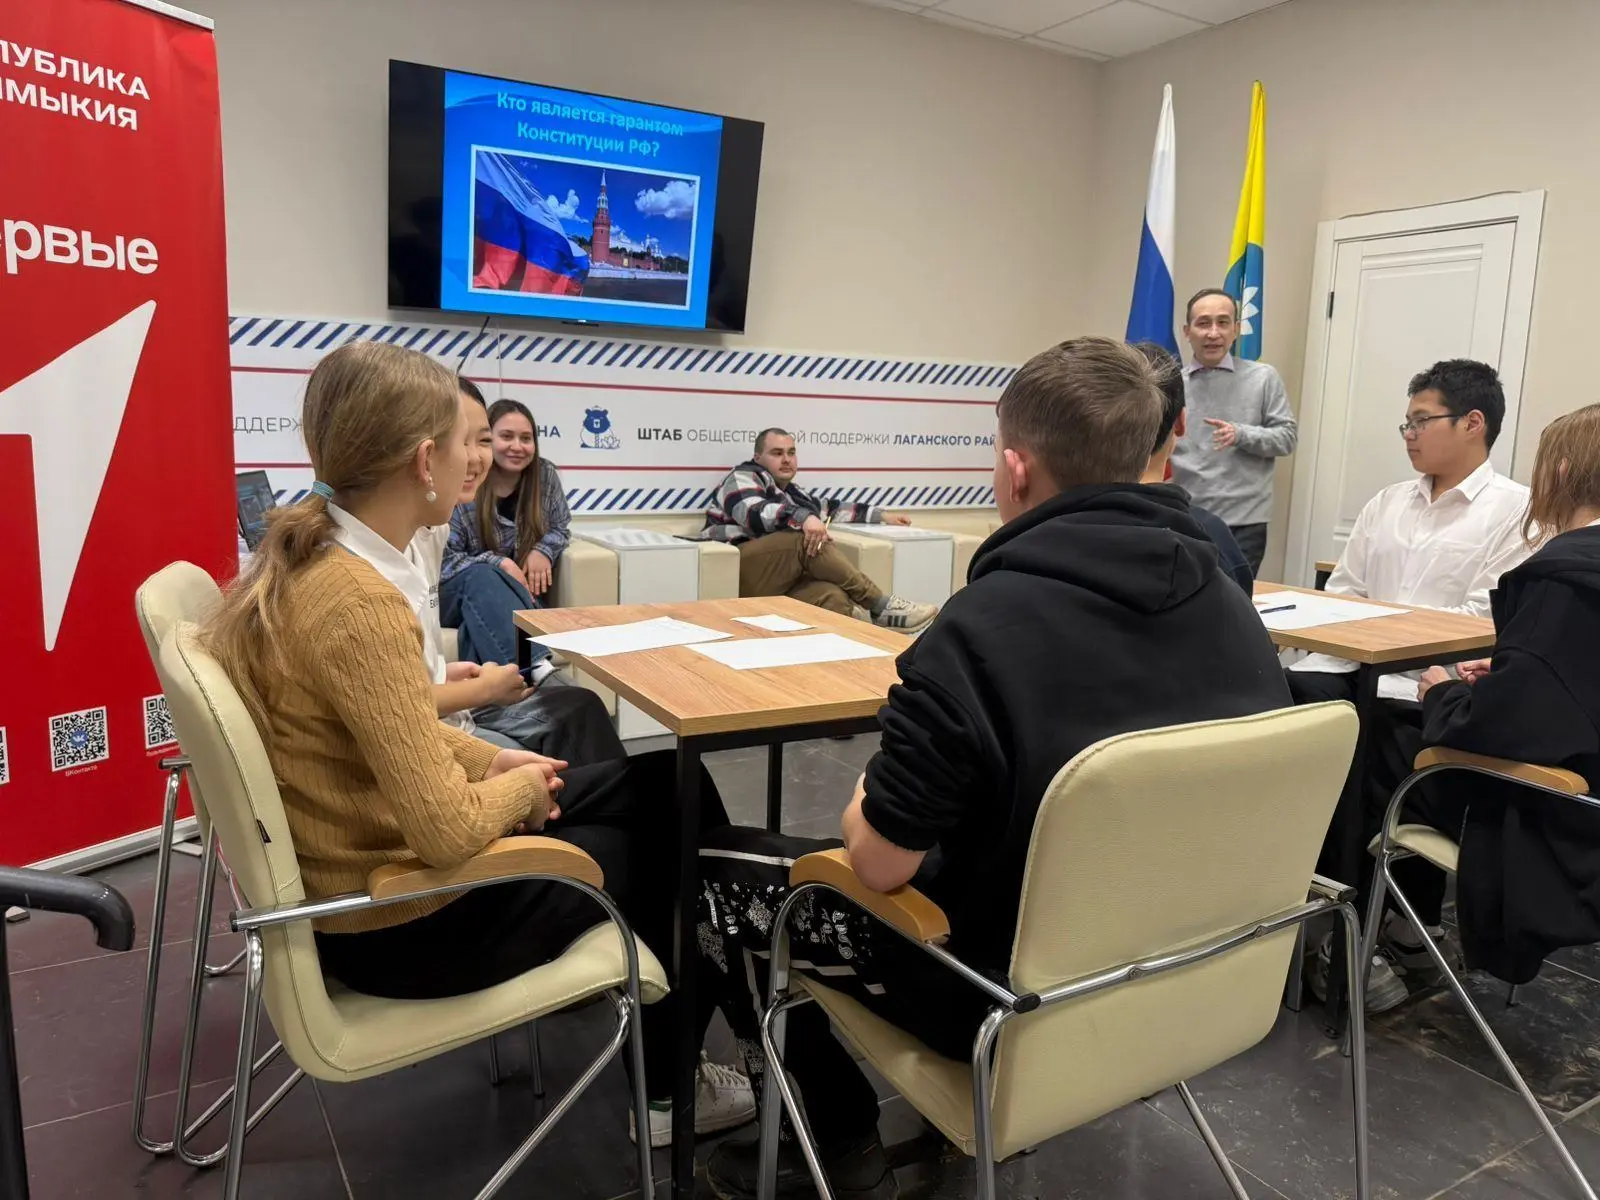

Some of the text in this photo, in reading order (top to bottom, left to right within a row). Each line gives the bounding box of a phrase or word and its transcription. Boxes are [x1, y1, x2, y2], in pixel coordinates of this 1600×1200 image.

[0, 76, 138, 131] МЫКИЯ
[497, 91, 684, 136] Кто является гарантом
[517, 121, 660, 157] Конституции РФ?
[0, 218, 159, 275] рвые
[637, 427, 683, 441] ШТАБ
[687, 428, 806, 443] ОБЩЕСТВОЙ
[810, 431, 890, 446] ПОДДЕРЖКИ
[893, 434, 972, 446] ЛАГАНСКОГО
